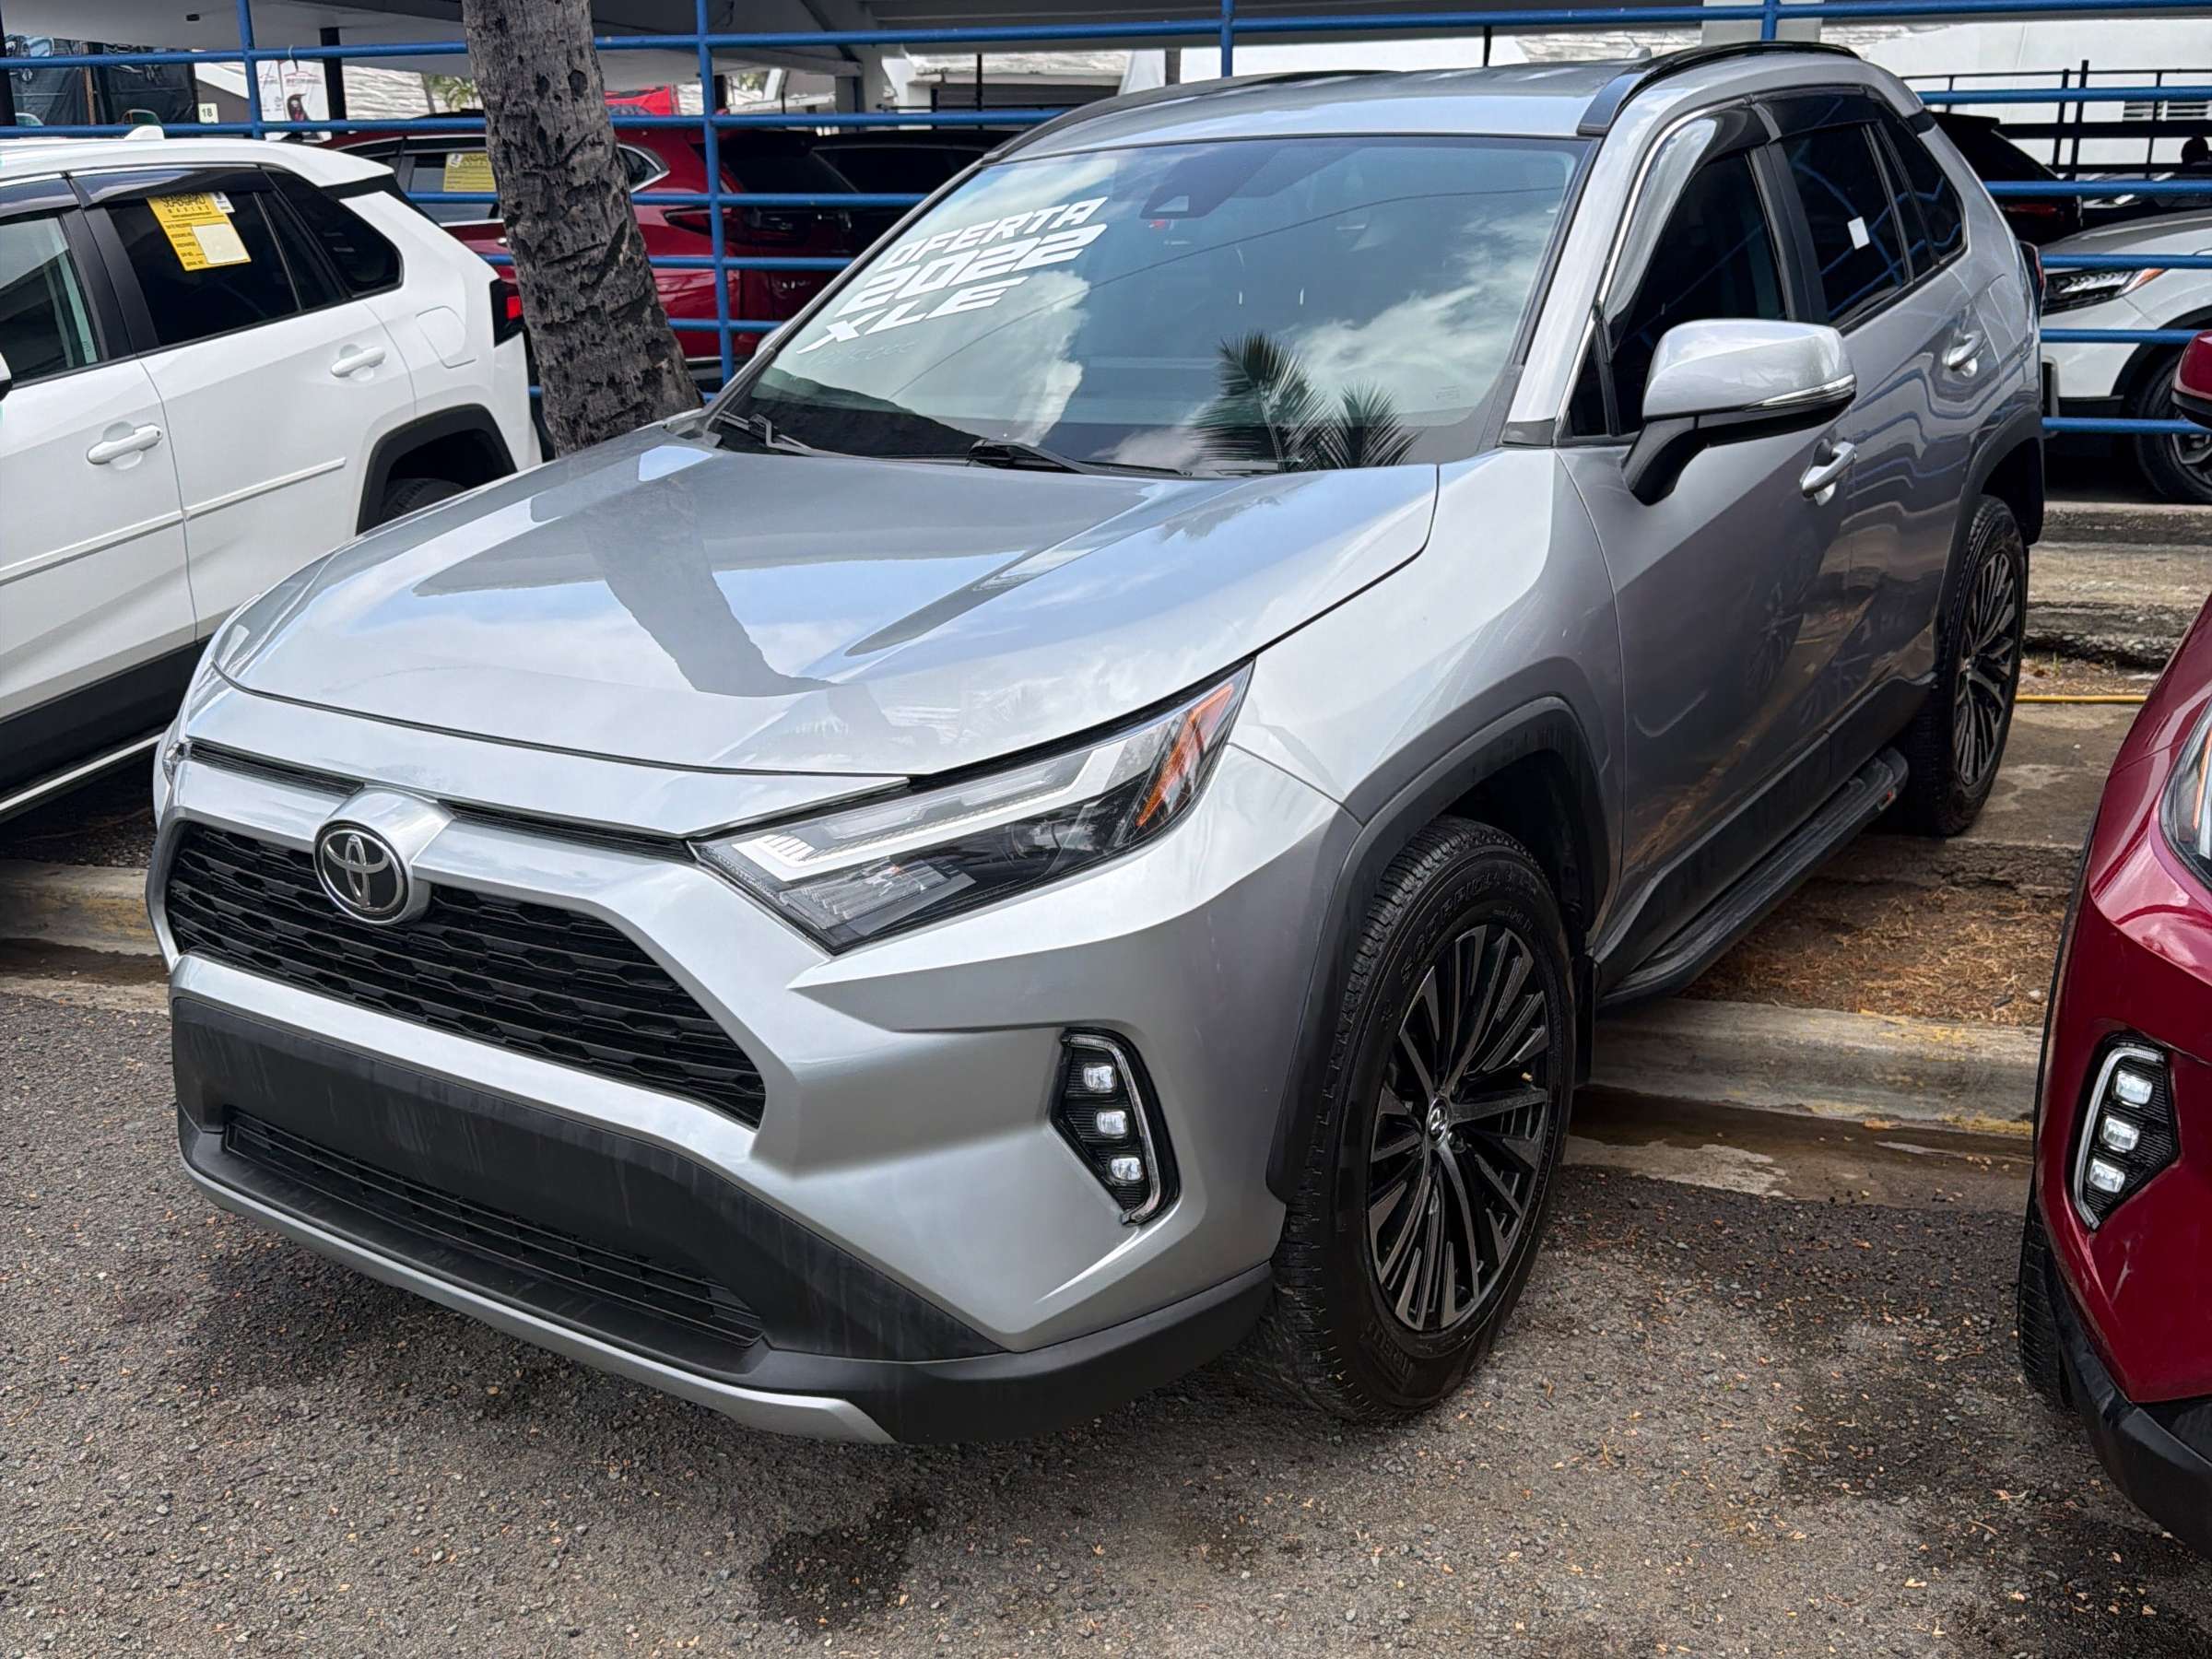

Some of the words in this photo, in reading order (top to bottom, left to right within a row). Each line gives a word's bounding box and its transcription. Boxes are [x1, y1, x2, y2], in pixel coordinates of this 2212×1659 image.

[201, 107, 214, 118] 18
[834, 224, 1108, 317] 2022
[877, 196, 1108, 271] OFERTA
[796, 276, 1029, 354] XLE
